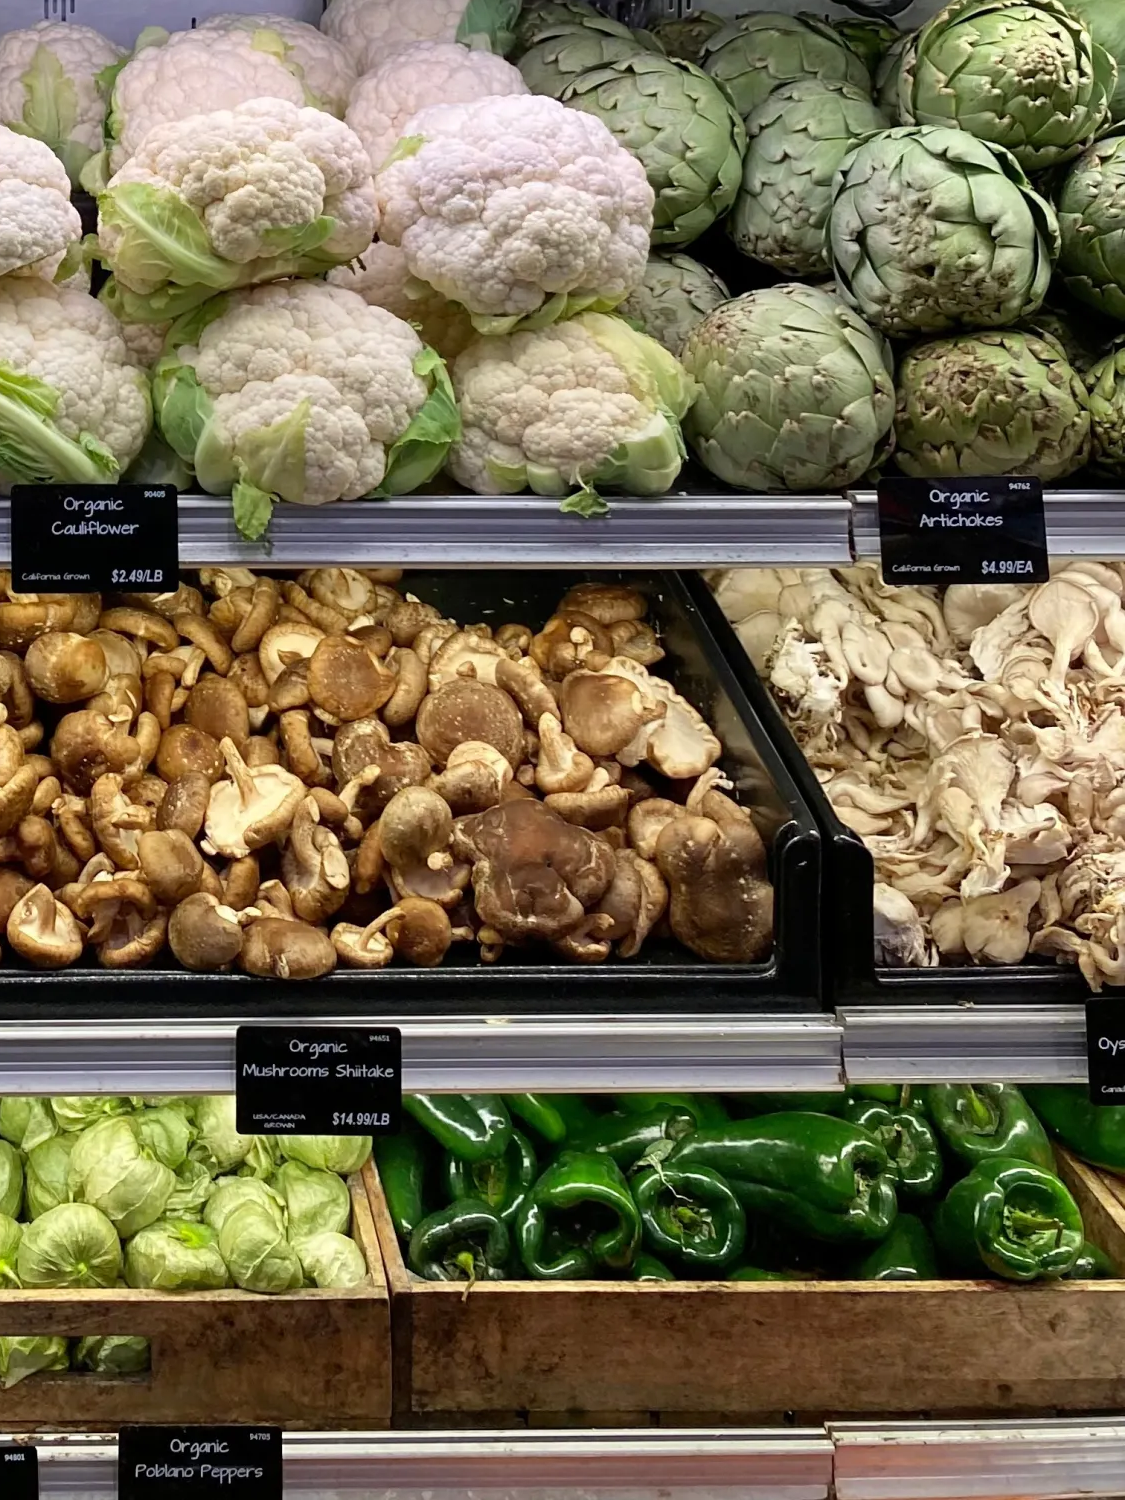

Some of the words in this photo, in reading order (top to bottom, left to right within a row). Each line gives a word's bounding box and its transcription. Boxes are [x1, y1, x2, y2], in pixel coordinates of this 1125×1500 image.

[929, 489, 990, 509] Organic
[64, 497, 124, 517] Organic
[919, 514, 1003, 527] Artichokes
[51, 521, 139, 535] Cauliflower
[934, 564, 960, 572] Grown
[981, 561, 1033, 574] $4.99/EA
[22, 573, 61, 581] California
[112, 569, 163, 583] $2.49/LB
[289, 1039, 348, 1059] Organic
[243, 1063, 329, 1077] Mushrooms
[335, 1064, 394, 1078] Shiitake
[332, 1112, 390, 1126] $14.99/LB
[170, 1439, 229, 1460] Organic
[135, 1464, 194, 1478] Poblano
[200, 1464, 263, 1484] Peppers
